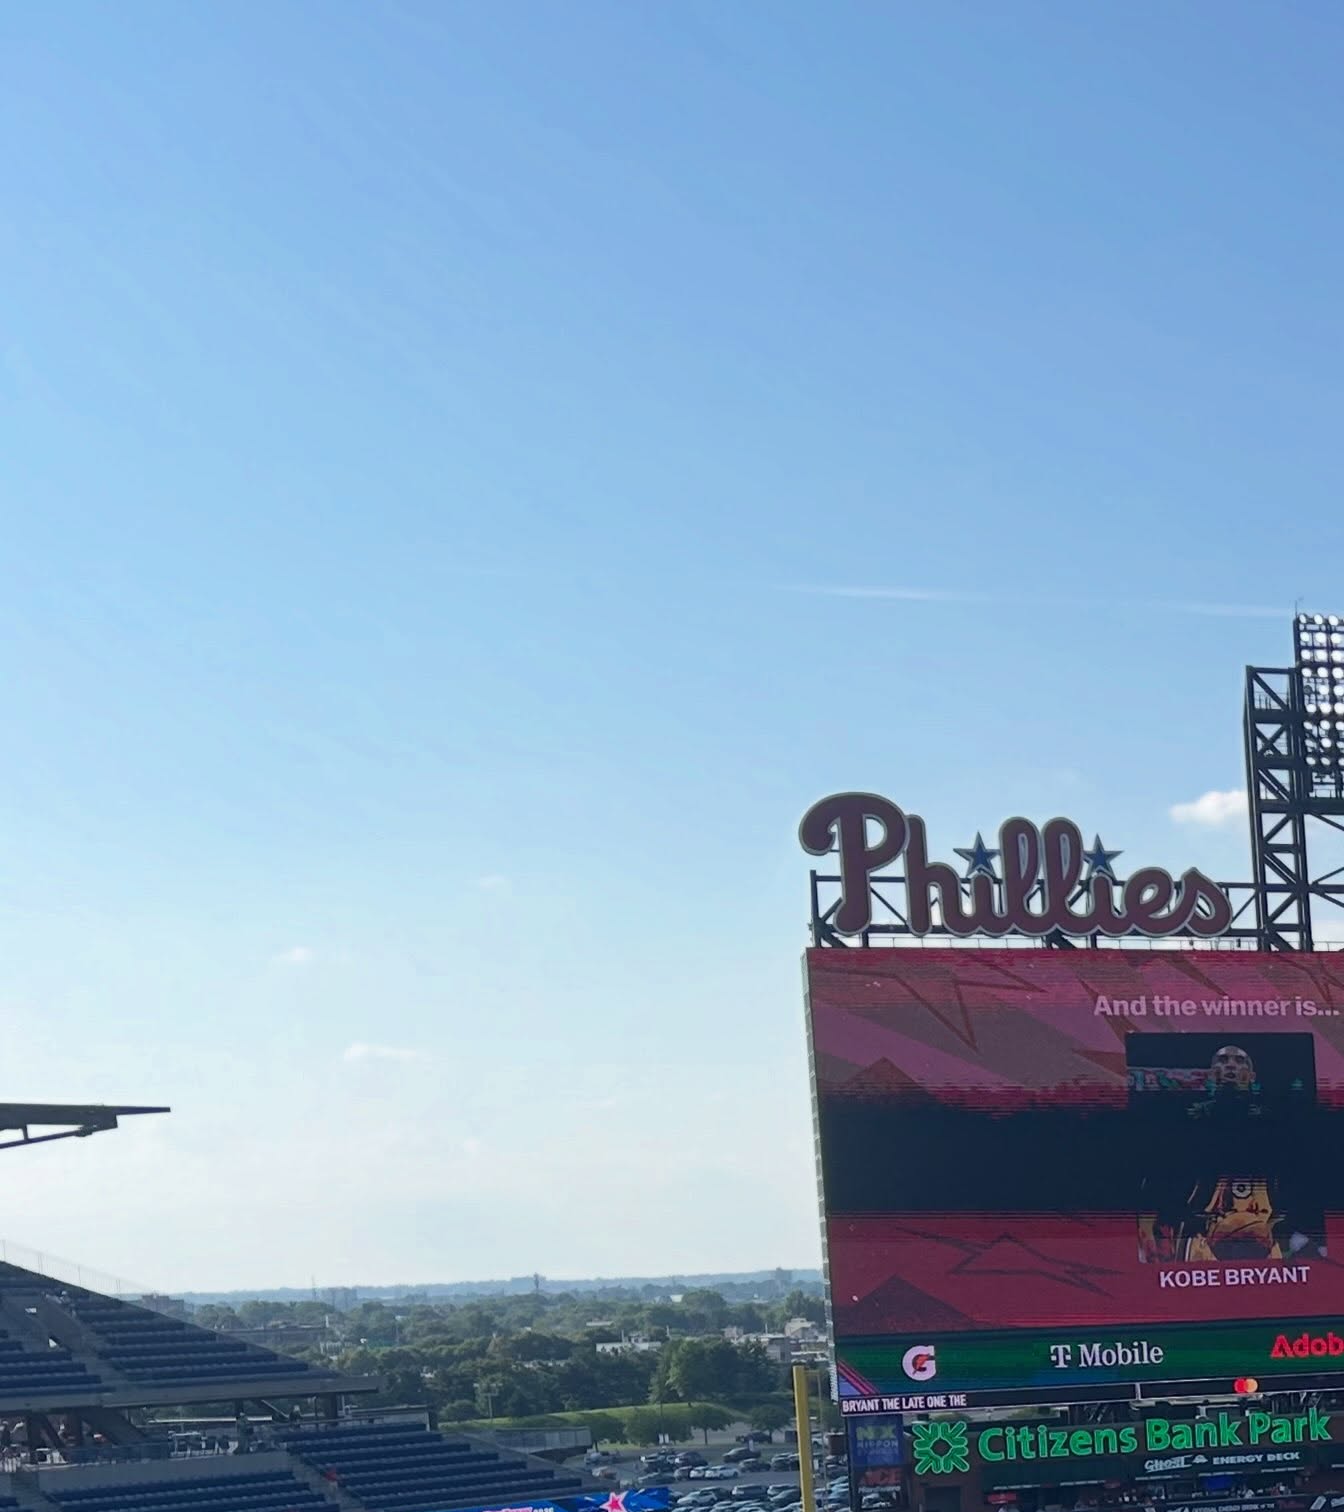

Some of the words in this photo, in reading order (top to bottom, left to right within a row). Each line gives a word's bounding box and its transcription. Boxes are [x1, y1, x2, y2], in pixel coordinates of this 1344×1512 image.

[798, 791, 1232, 937] Phillies
[1094, 996, 1148, 1016] And
[1153, 996, 1196, 1016] the
[1201, 996, 1293, 1017] winner
[1295, 996, 1339, 1017] is...
[1160, 1269, 1220, 1287] KOBE
[1225, 1266, 1310, 1285] BRYANT
[902, 1345, 937, 1381] G
[1078, 1342, 1164, 1367] Mobile
[842, 1400, 880, 1413] BRYANT
[882, 1398, 900, 1411] THE
[902, 1397, 925, 1410] LATE
[927, 1396, 947, 1408] ONE
[949, 1395, 967, 1407] THE
[978, 1422, 1138, 1462] Citizens
[1145, 1411, 1243, 1451] Bank
[1250, 1408, 1334, 1445] Park
[1212, 1454, 1264, 1465] ENERGY
[1267, 1452, 1300, 1462] DECK
